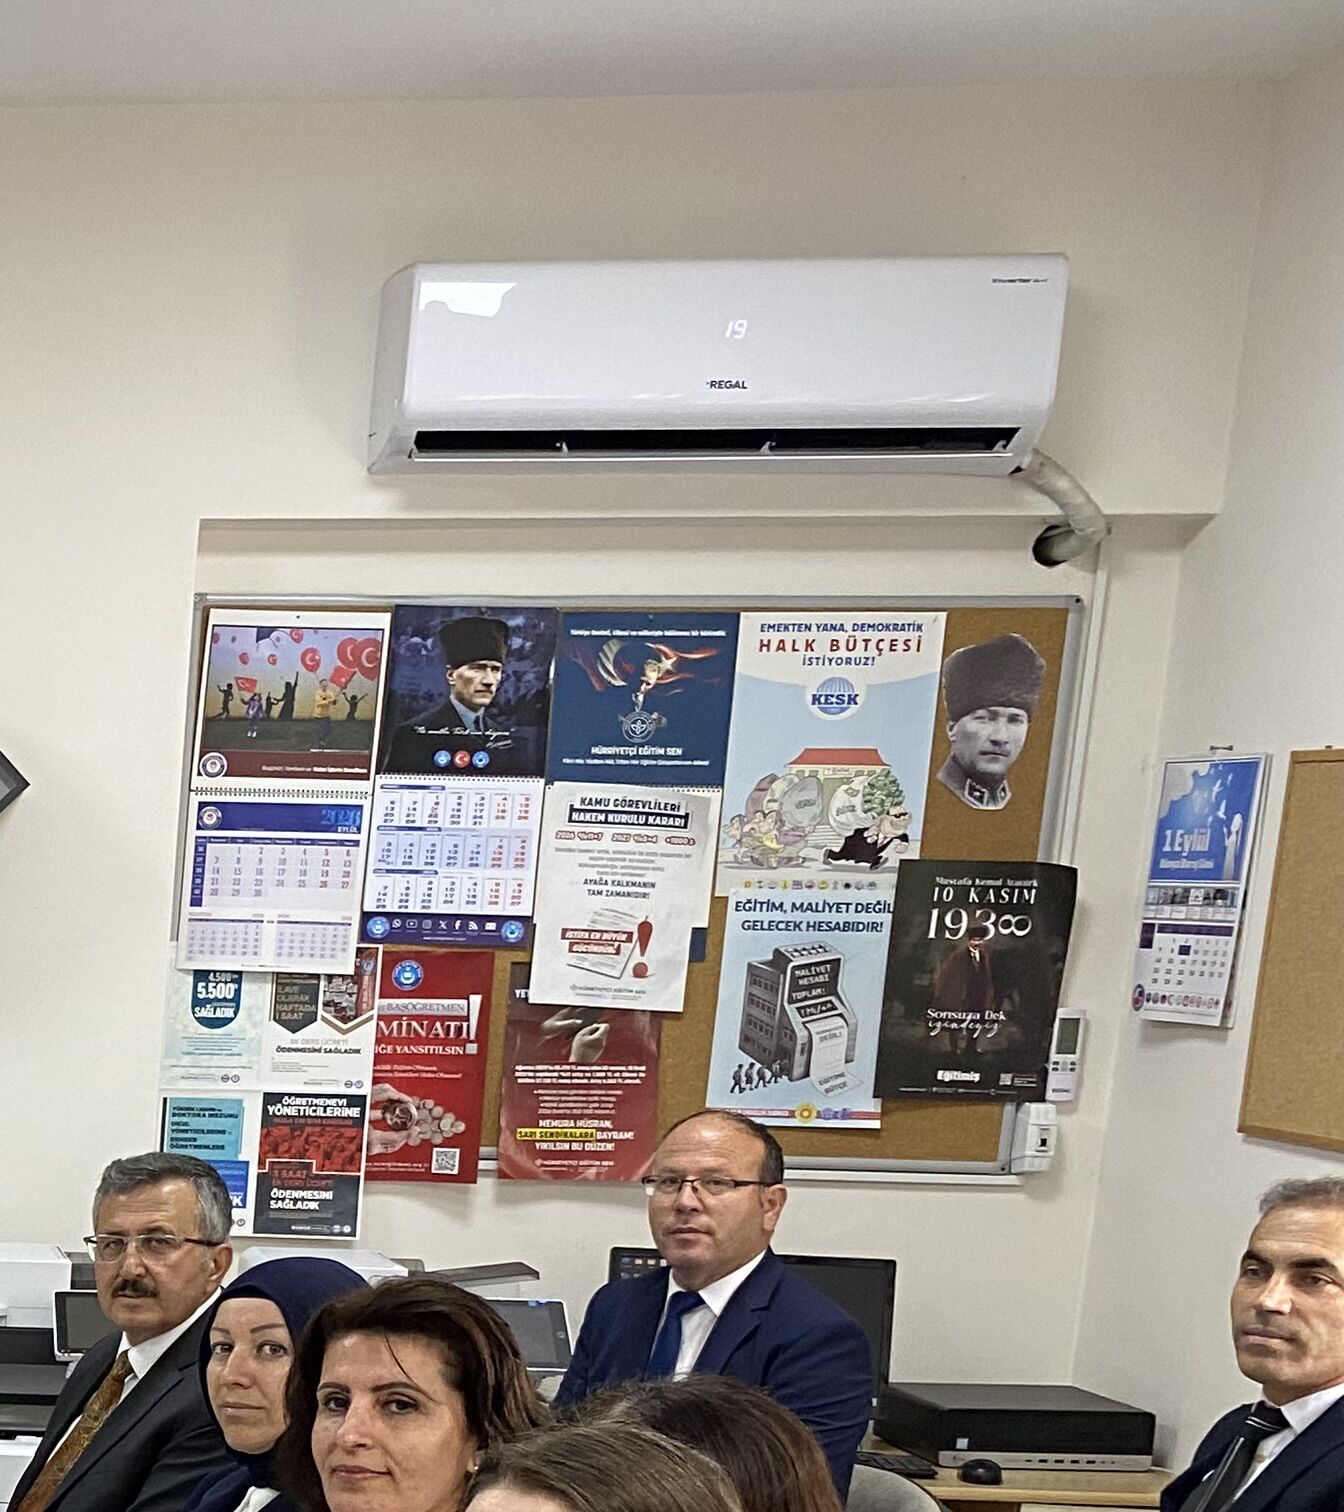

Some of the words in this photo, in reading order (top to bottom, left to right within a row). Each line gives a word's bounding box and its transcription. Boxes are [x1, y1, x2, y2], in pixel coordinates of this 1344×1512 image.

[725, 320, 747, 338] 19
[710, 380, 748, 390] REGAL
[760, 623, 811, 632] EMEKTEN
[815, 623, 849, 633] YANA,
[851, 621, 923, 632] DEMOKRATİK
[760, 639, 816, 652] HALK
[830, 635, 922, 656] BÜTÇESİ
[802, 655, 875, 666] İSTİYORUZ!
[811, 694, 859, 705] KESK
[580, 797, 610, 807] KAMU
[613, 796, 680, 812] GÖREVLİLERİ
[571, 811, 606, 822] HAKEM
[608, 813, 646, 824] KURULU
[648, 814, 684, 827] KARARI
[1162, 829, 1172, 852] 1
[1173, 828, 1211, 856] Eylül
[583, 877, 608, 886] AYAĞA
[935, 877, 972, 886] Mustafa
[975, 877, 1003, 886] Kemal
[587, 889, 603, 897] TAM
[933, 887, 954, 902] 10
[969, 888, 1037, 904] KASIM
[735, 899, 787, 914] EĞİTİM,
[791, 899, 851, 914] MALİYET
[855, 900, 893, 914] DEĞİL
[741, 920, 802, 932] GELECEK
[806, 921, 883, 933] HESABIDIR!
[197, 982, 235, 999] 5.500
[194, 1004, 235, 1018] SAĞLADIK
[387, 1002, 464, 1012] BAŞÖĞRETMEN
[926, 1008, 980, 1020] Sonsuza
[984, 1010, 1006, 1021] Dek
[378, 1017, 468, 1038] MİNATI
[395, 1045, 463, 1054] YANSITILSIN
[267, 1105, 361, 1117] YÖNETİCİLERİNE
[270, 1188, 333, 1200] ÖDENMESİNİ
[269, 1199, 320, 1210] SAĞLADIK
